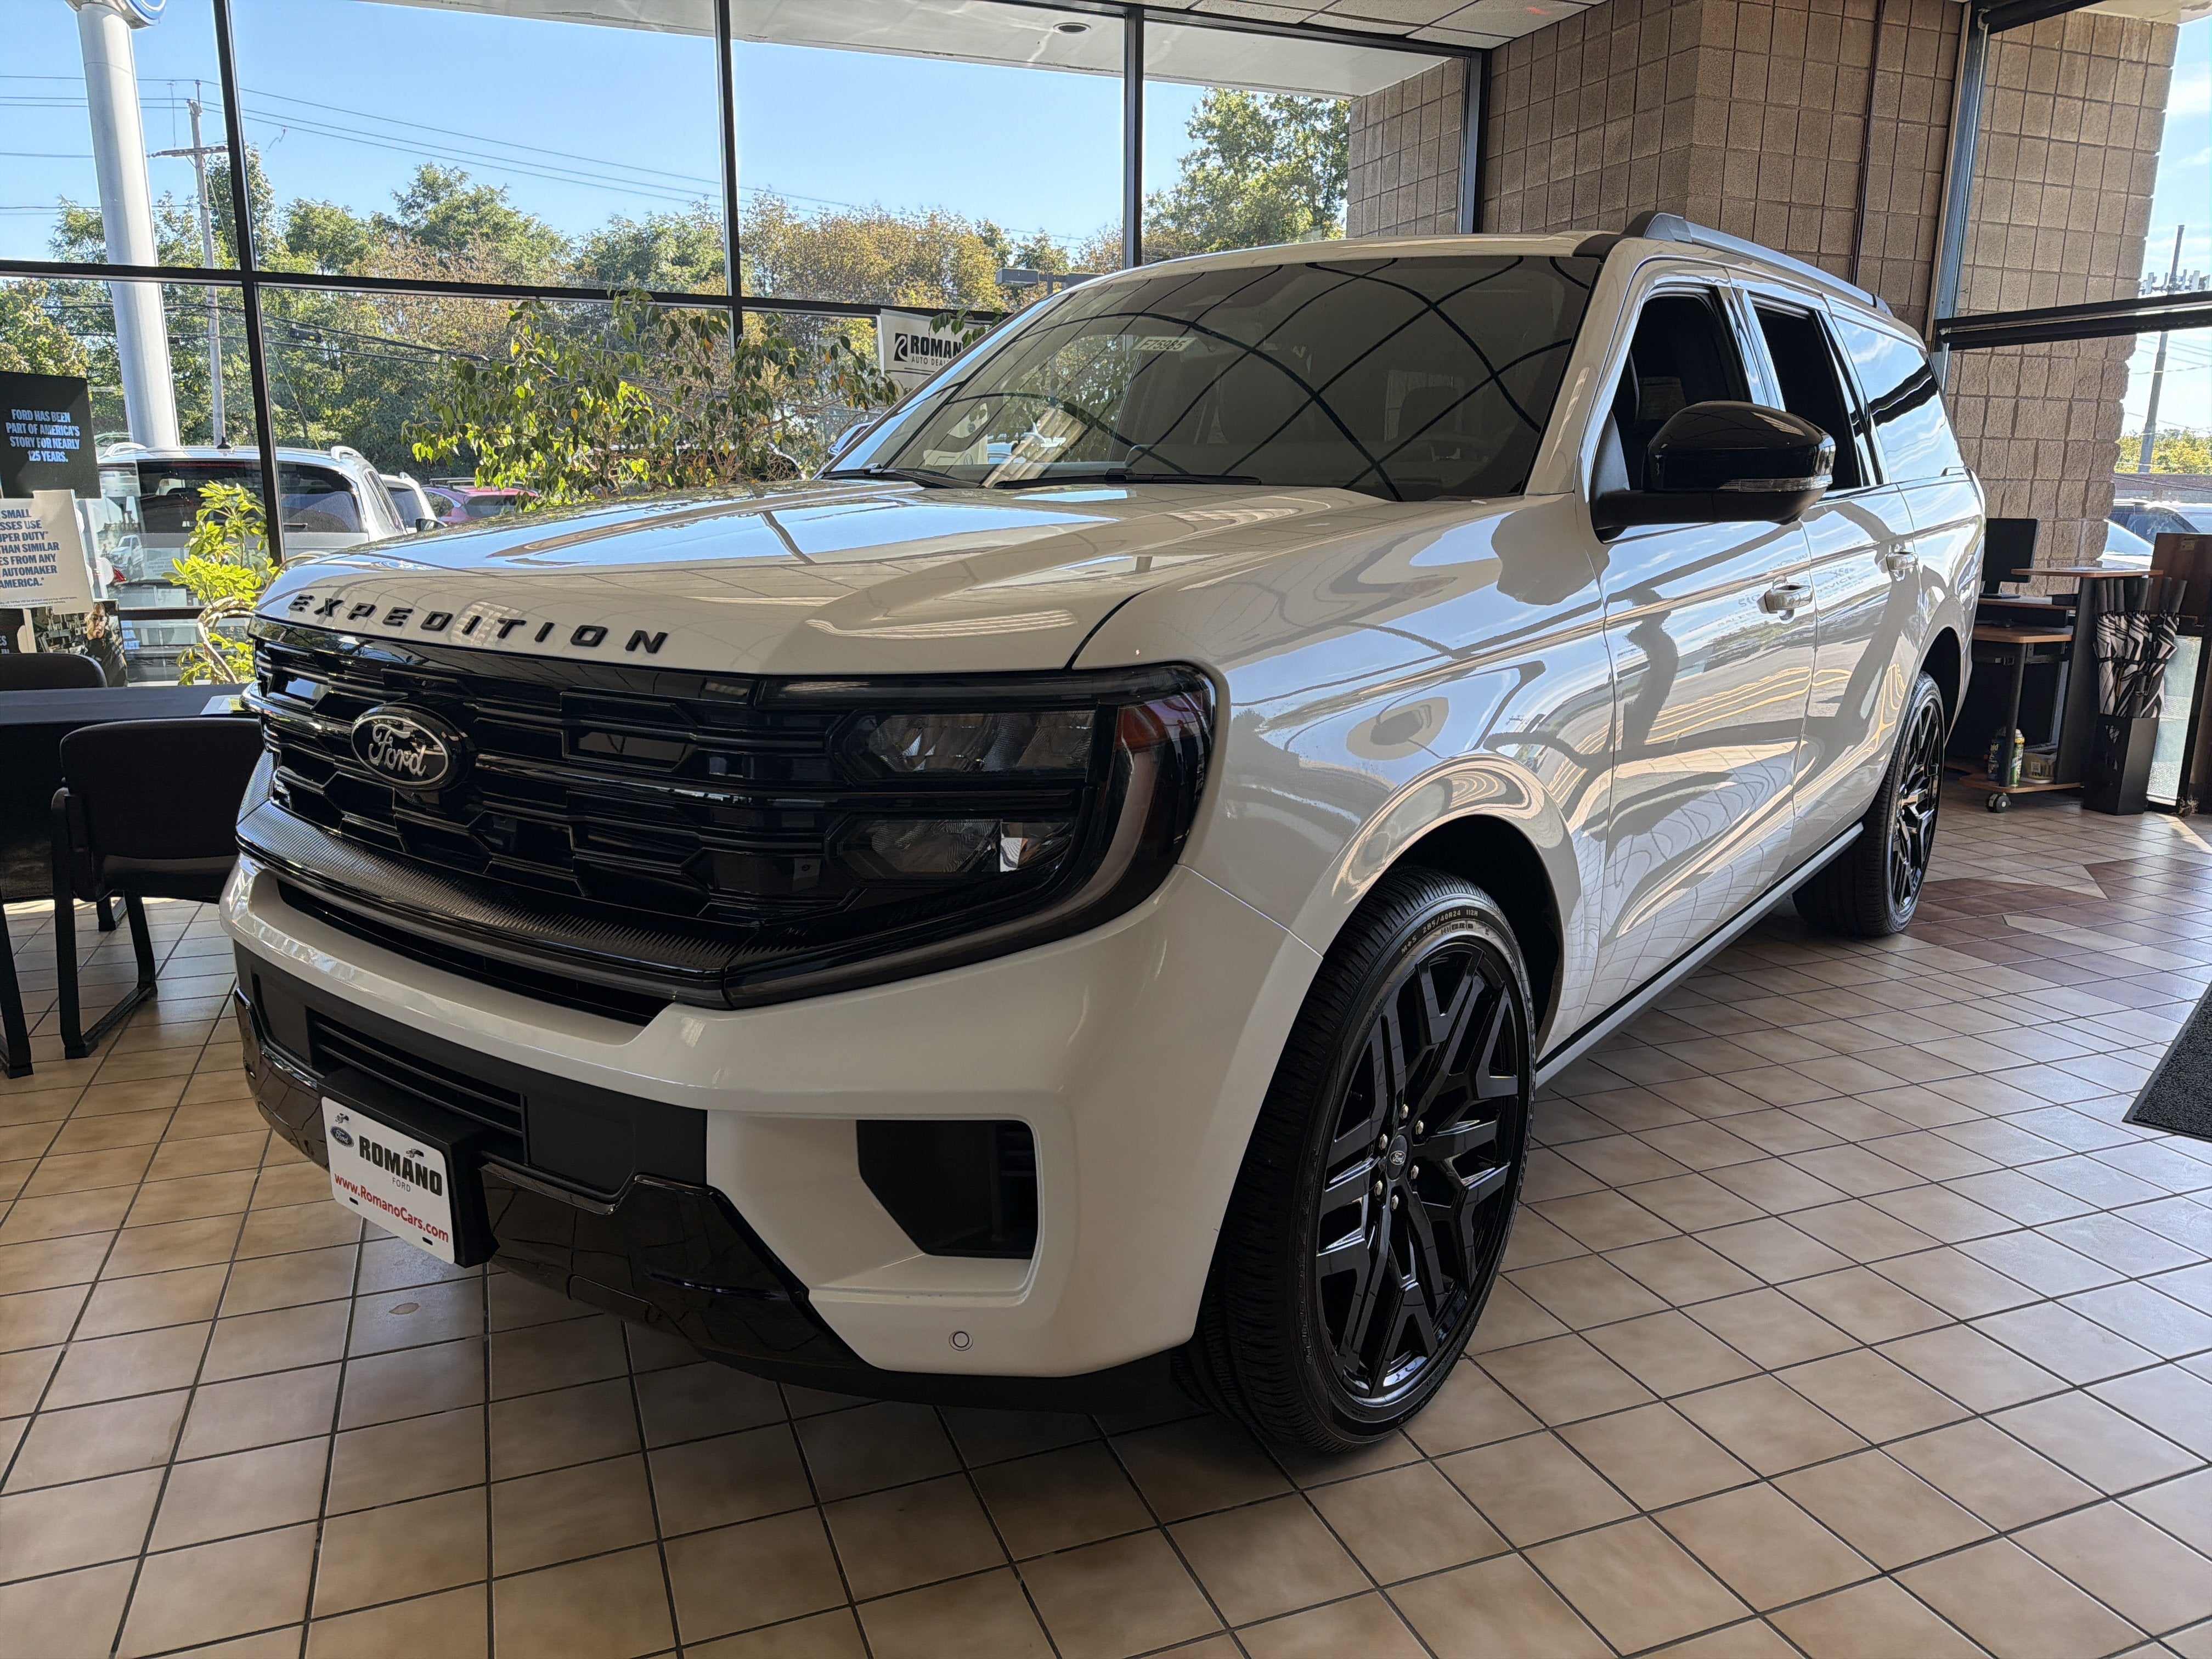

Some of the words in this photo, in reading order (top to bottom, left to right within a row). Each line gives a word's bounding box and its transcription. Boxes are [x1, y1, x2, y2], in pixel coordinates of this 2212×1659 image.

[911, 356, 928, 365] AUTO
[931, 358, 949, 367] DEA
[11, 409, 33, 421] FORD
[34, 410, 50, 422] HAS
[50, 411, 71, 423] BEEN
[5, 422, 26, 434] PART
[28, 424, 38, 435] OF
[40, 424, 81, 437] AMERICA'S
[9, 436, 35, 448] STORY
[36, 437, 52, 448] FOR
[52, 438, 80, 450] NEARLY
[27, 450, 41, 461] 125
[41, 451, 69, 462] YEARS.
[1, 509, 32, 519] SMALL
[24, 520, 42, 529] USE
[21, 541, 60, 553] SIMILAR
[10, 554, 37, 565] FROM
[38, 553, 56, 563] ANY
[2, 565, 58, 577] AUTOMAKER
[287, 594, 669, 654] EXPEDITION
[368, 723, 427, 777] Ford
[1401, 935, 1417, 955] M+S
[1422, 910, 1461, 934] 285/40R24
[1466, 909, 1479, 917] 112H
[335, 1129, 349, 1144] Ford
[359, 1135, 443, 1197] ROMANO
[392, 1177, 411, 1192] FORD
[334, 1173, 449, 1243] www.RomanoCars.com
